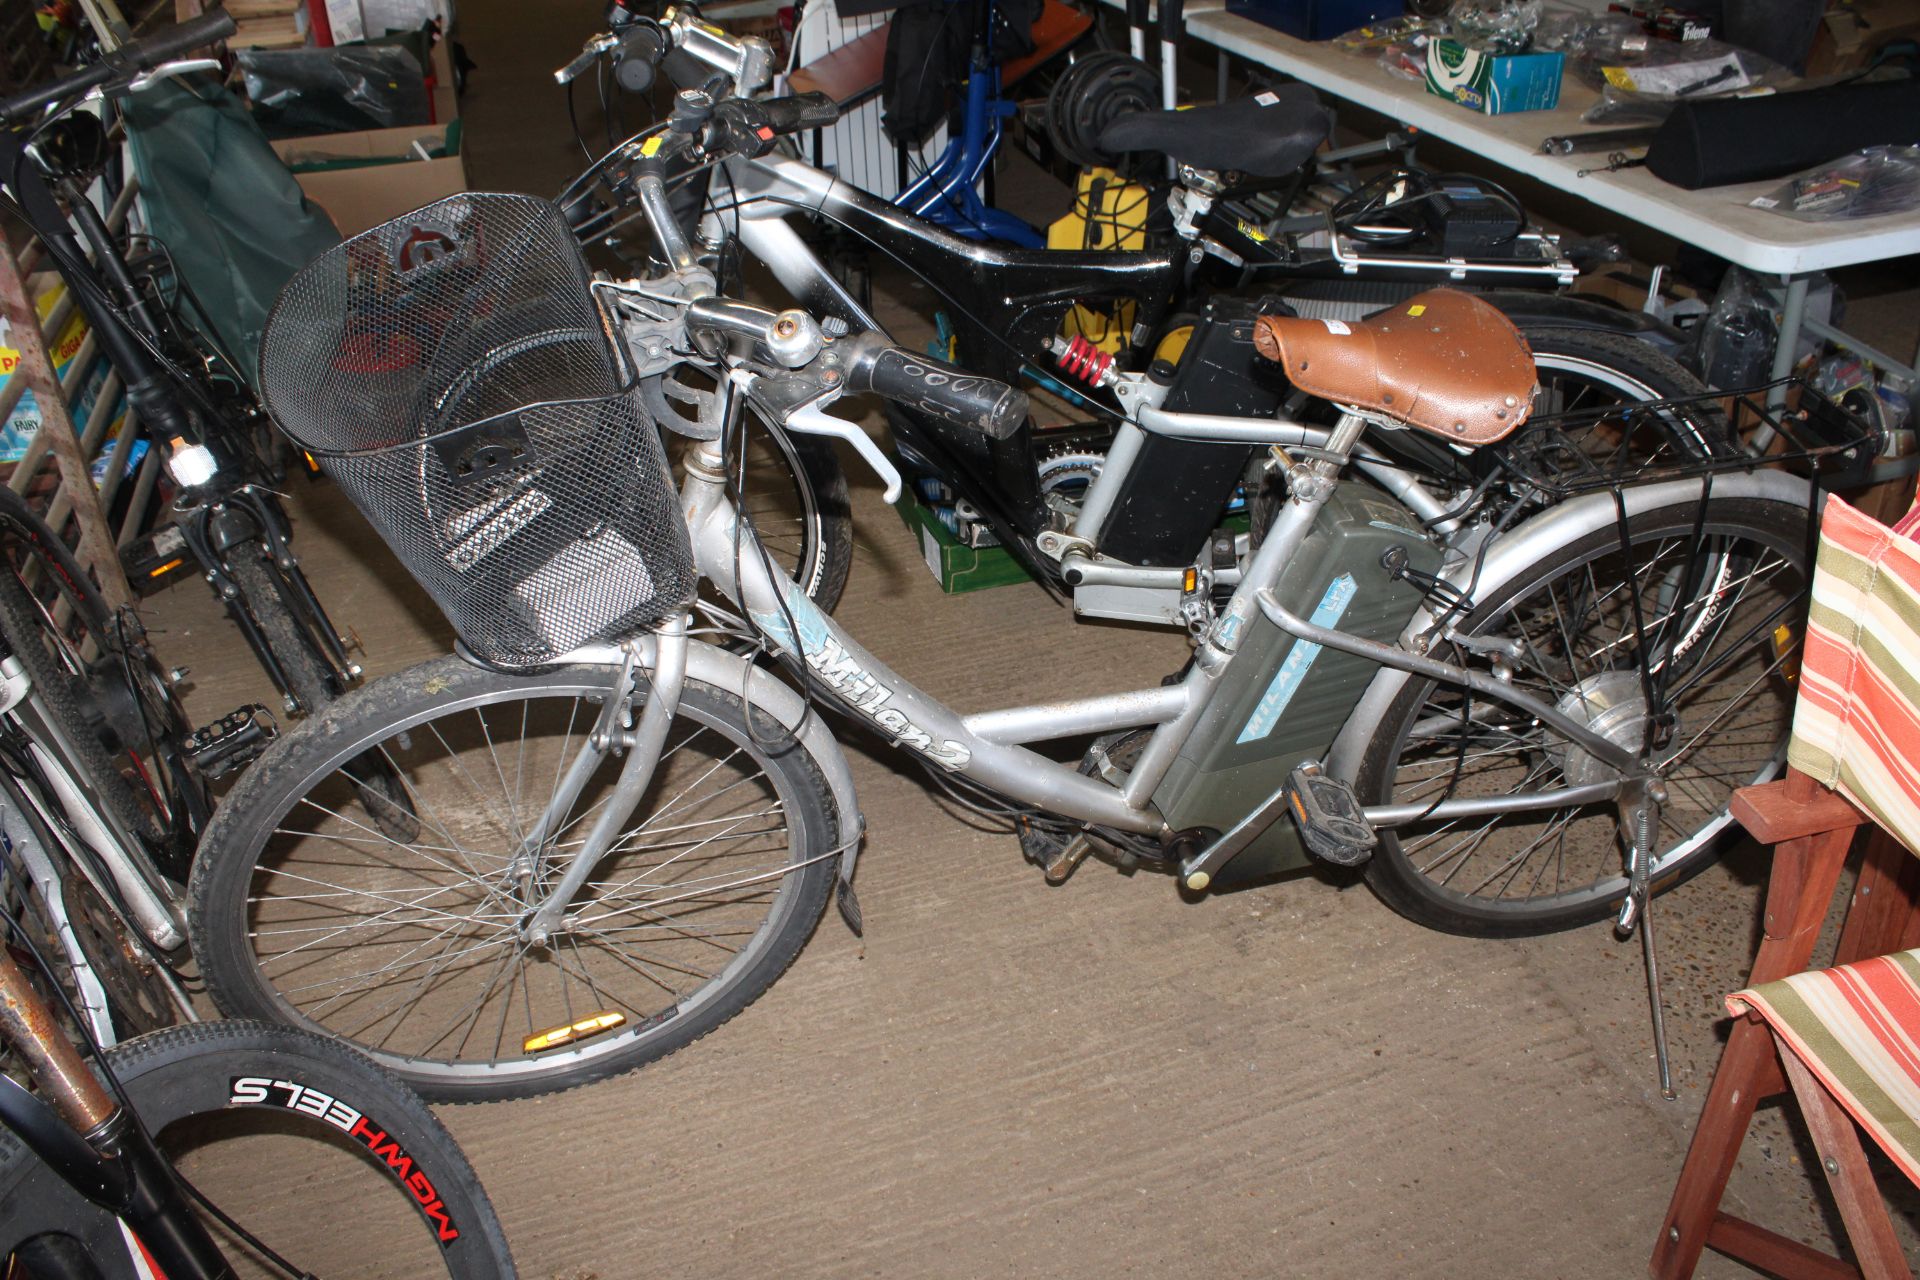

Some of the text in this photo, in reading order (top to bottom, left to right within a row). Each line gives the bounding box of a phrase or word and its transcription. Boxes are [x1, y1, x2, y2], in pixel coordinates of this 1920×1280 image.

[1682, 25, 1711, 41] Trilene
[14, 419, 39, 432] FAIRY
[230, 1077, 459, 1242] MGWHEELS
